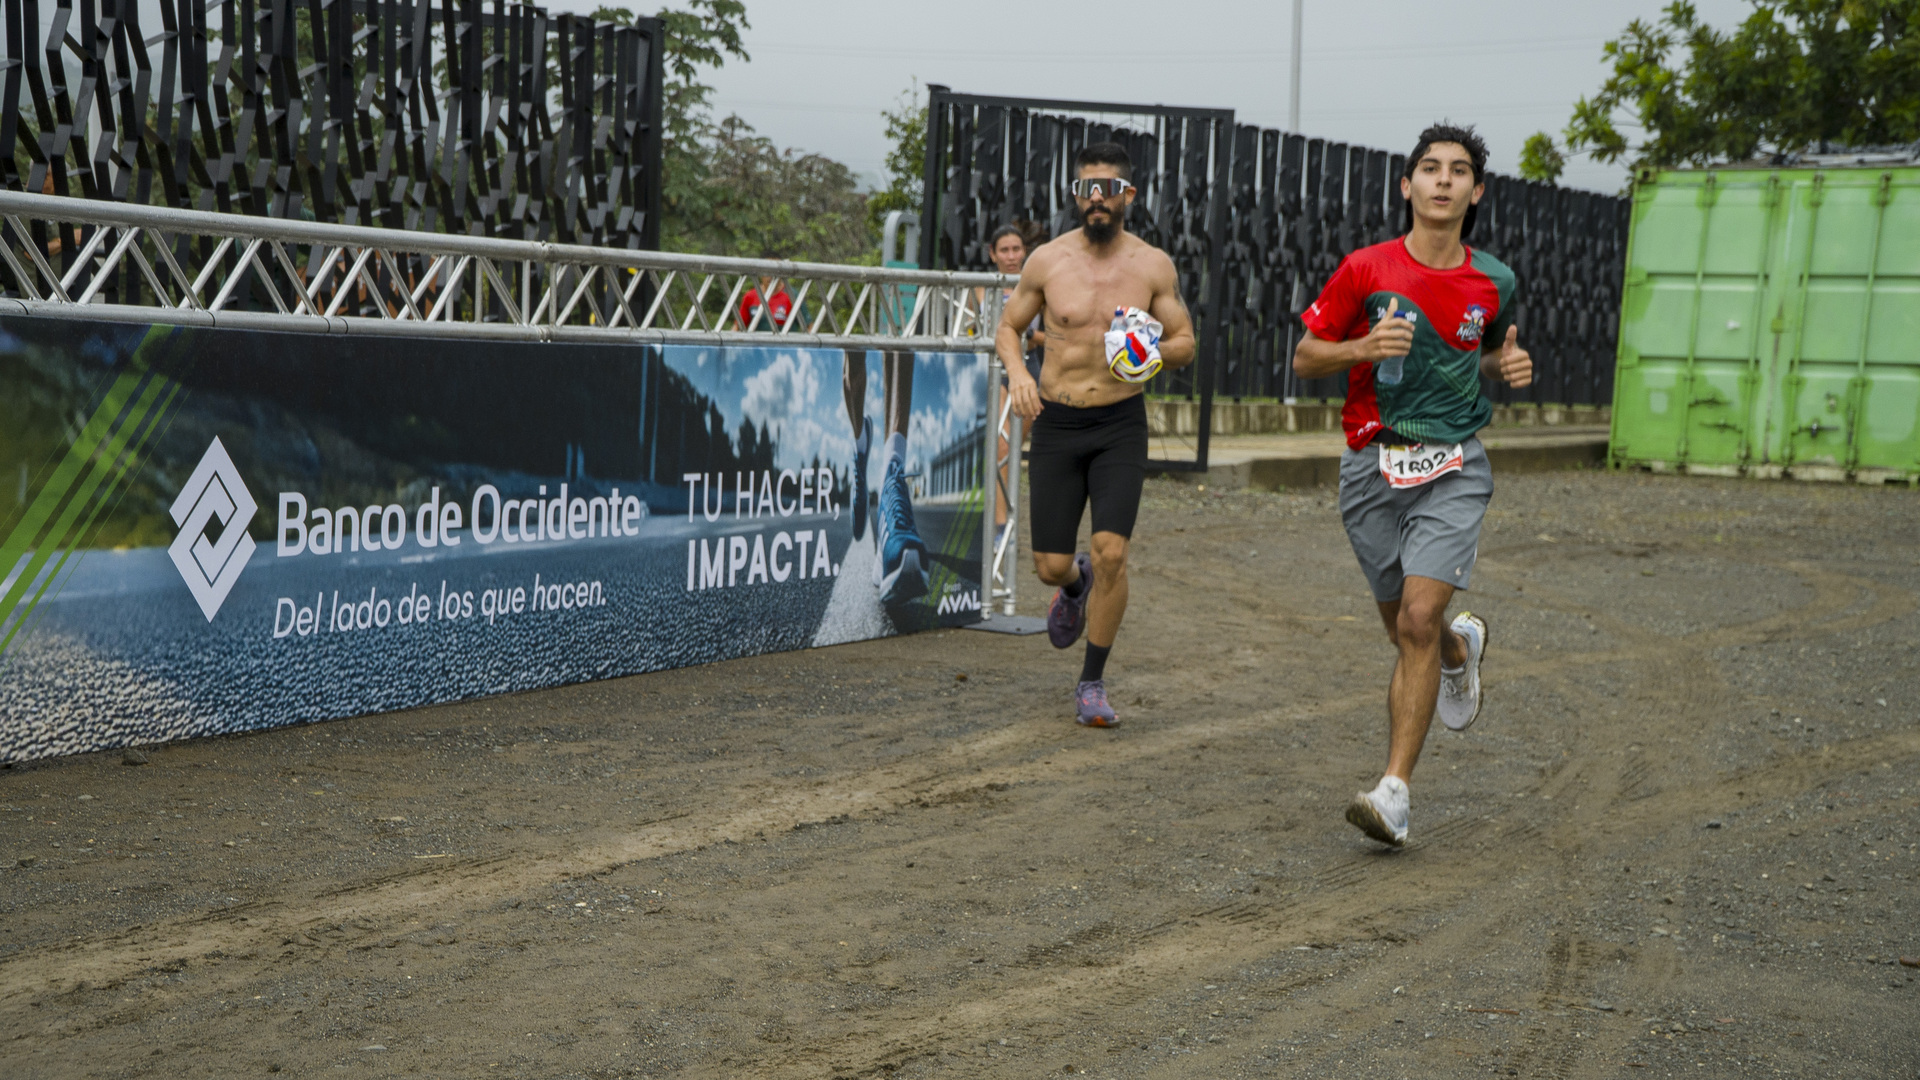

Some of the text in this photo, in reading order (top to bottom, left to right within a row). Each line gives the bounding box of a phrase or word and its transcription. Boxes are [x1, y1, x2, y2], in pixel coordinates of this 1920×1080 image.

[277, 482, 642, 558] Banco de Occidente
[683, 466, 841, 523] TU HACER,
[686, 529, 841, 591] IMPACTA.
[273, 573, 607, 640] Del lado de los que hacen.
[937, 589, 982, 616] AVAL
